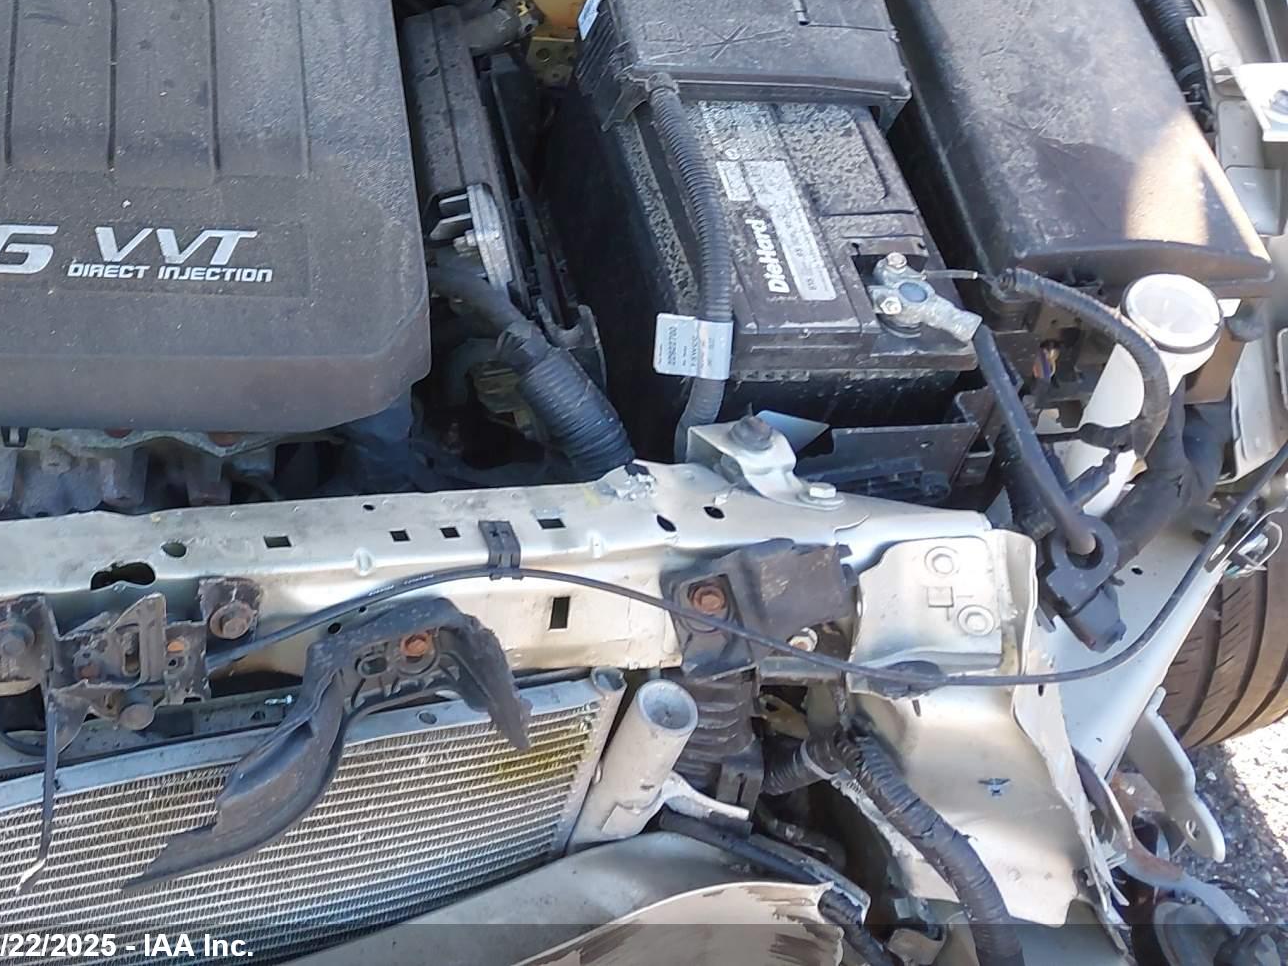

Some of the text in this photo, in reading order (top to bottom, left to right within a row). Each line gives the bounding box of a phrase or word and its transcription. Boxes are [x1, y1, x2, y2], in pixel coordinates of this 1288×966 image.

[95, 226, 258, 266] VVT
[745, 218, 791, 294] DieHard
[67, 263, 274, 283] DIRECT INJECTION
